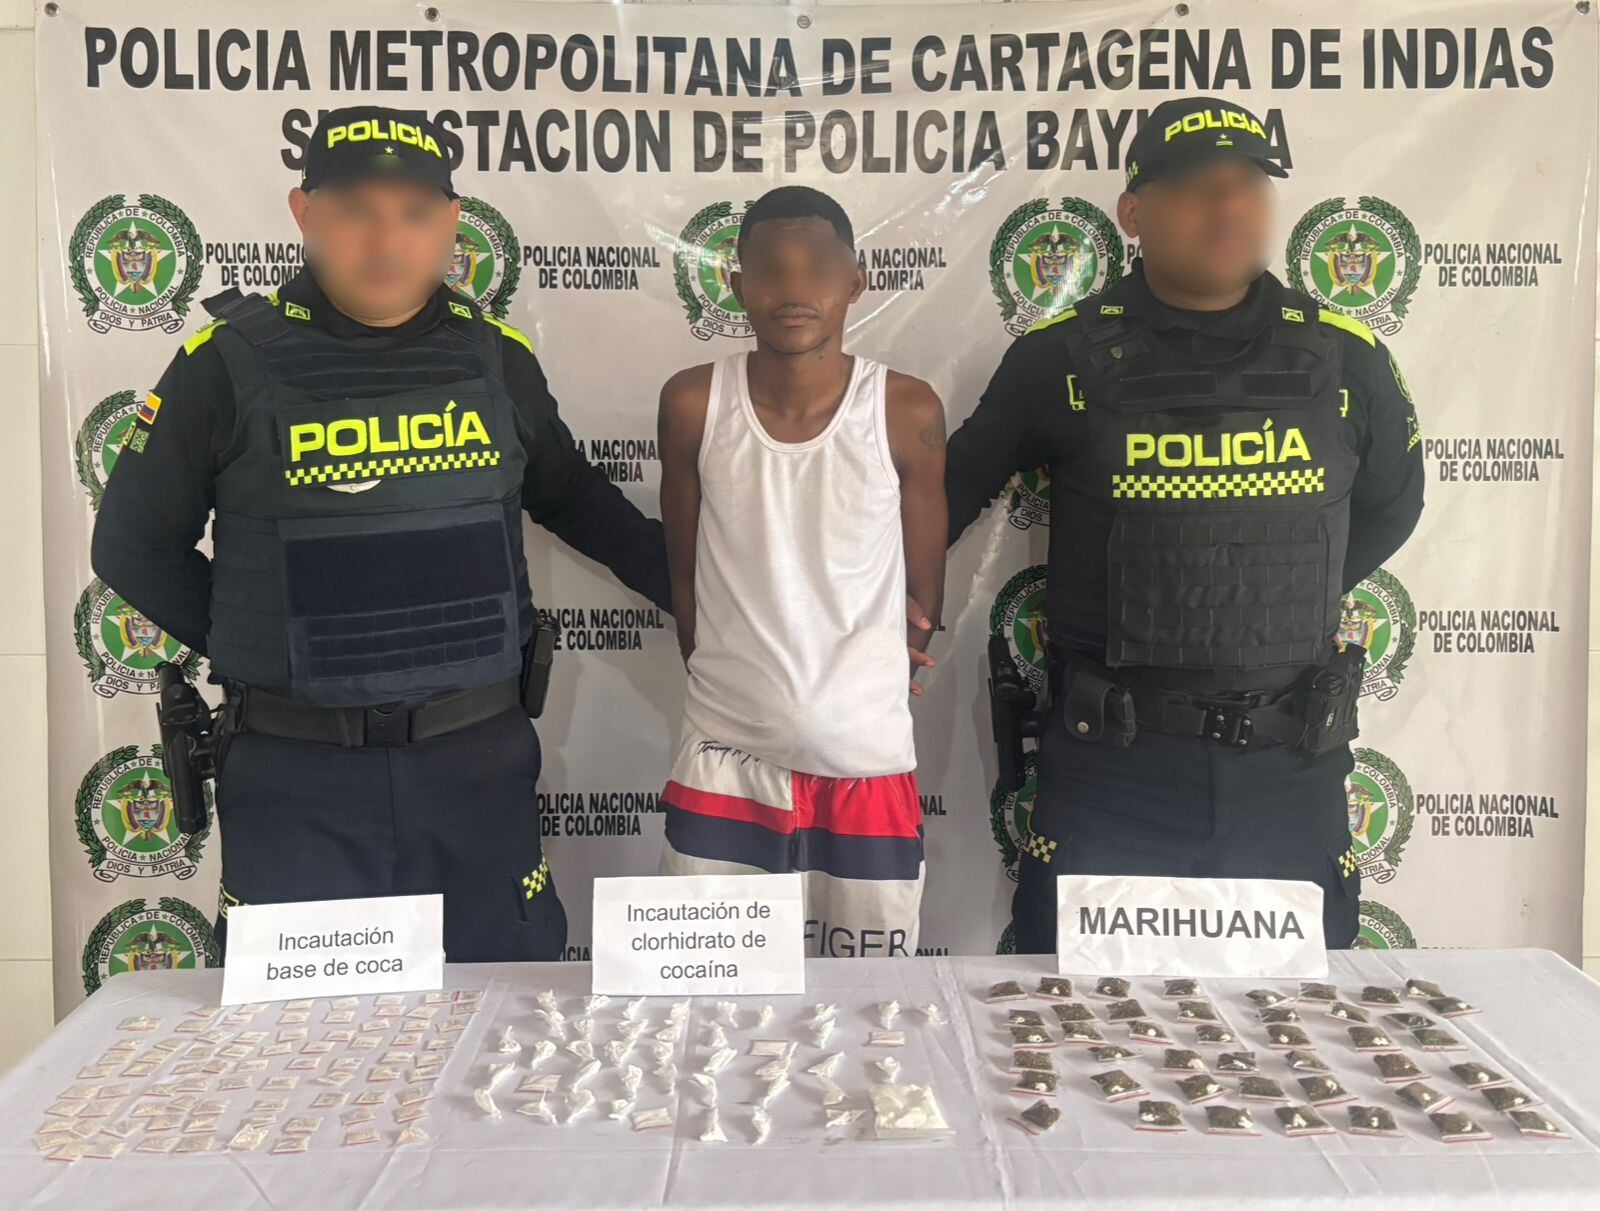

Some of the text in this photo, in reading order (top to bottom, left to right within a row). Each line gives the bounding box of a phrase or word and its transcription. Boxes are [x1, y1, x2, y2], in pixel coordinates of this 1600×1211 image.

[86, 27, 1554, 97] POLICIA METROPOLITANA DE CARTAGENA DE INDIAS
[281, 108, 1293, 174] SSTACION DE POLICIA BAYA
[85, 208, 185, 259] REPUBLICA DE COLOMBIA
[467, 215, 503, 260] COLOMBIA
[1005, 217, 1040, 263] REPUBLICA
[1048, 212, 1062, 220] DE
[1071, 216, 1106, 259] COLOMBIA
[1301, 211, 1404, 261] REPUBLICA DE COLOMBIA
[205, 243, 305, 264] POLICIA NACI
[523, 245, 660, 268] POLICIA NACIONAL
[871, 247, 947, 269] NACIONAL
[1424, 243, 1562, 264] POLICIA NACIONAL
[221, 265, 300, 286] DE COLOM
[539, 268, 639, 290] DE COLOMBIA
[868, 270, 924, 291] LOMBIA
[1438, 266, 1539, 287] DE COLOMBIA
[95, 285, 179, 314] POLICIA NACIONAL
[698, 294, 731, 320] POLICIA
[1355, 287, 1398, 316] NACIONAL
[99, 311, 173, 328] DIOS Y PATRIA
[702, 319, 725, 333] DIOS
[731, 326, 738, 335] Y
[1364, 314, 1392, 328] ATRIA
[93, 408, 129, 453] REPUBLICA
[290, 401, 491, 462] POLICÍA
[591, 440, 660, 460] NACIONA
[1126, 419, 1311, 468] POLICÍA
[1425, 438, 1564, 460] POLICIA NACIONAL
[1439, 461, 1539, 482] DE COLOMBIA
[1017, 483, 1049, 509] POLICIA
[1021, 508, 1043, 521] DIOS
[92, 590, 115, 624] REPUBL
[1005, 583, 1041, 627] REPUBLICA
[1366, 582, 1400, 625] COLOMBIA
[590, 609, 664, 629] NACIONAL
[1419, 610, 1560, 632] POLICIA NACIONAL
[567, 630, 643, 651] COLOMBIA
[1433, 632, 1535, 653] DE COLOMBIA
[101, 651, 136, 678] POLICIA
[1364, 653, 1393, 679] CIONAL
[106, 676, 129, 690] DIOS
[136, 683, 142, 692] Y
[1360, 680, 1388, 694] ATRIA
[93, 758, 152, 809] REPUBLICA DE
[1363, 766, 1397, 808] COLOMBIA
[537, 793, 585, 814] OLICIA
[1416, 794, 1559, 819] POLICIA NACIONAL
[542, 815, 641, 836] DE COLOMBIA
[1431, 816, 1534, 838] DE COLOMBIA
[102, 836, 138, 860] POLICIA
[1357, 836, 1390, 862] ACIONAL
[106, 860, 186, 875] DIOS Y PATRIA
[1359, 863, 1385, 876] ATRIA
[627, 901, 771, 922] Incautación de
[1079, 906, 1305, 940] MARIHUANA
[99, 911, 204, 964] REPUBLICA DE COLOMBIA
[278, 927, 394, 951] Incautación
[631, 930, 766, 951] clorhidrato de
[266, 957, 403, 981] base de coca
[660, 960, 738, 979] cocaína
